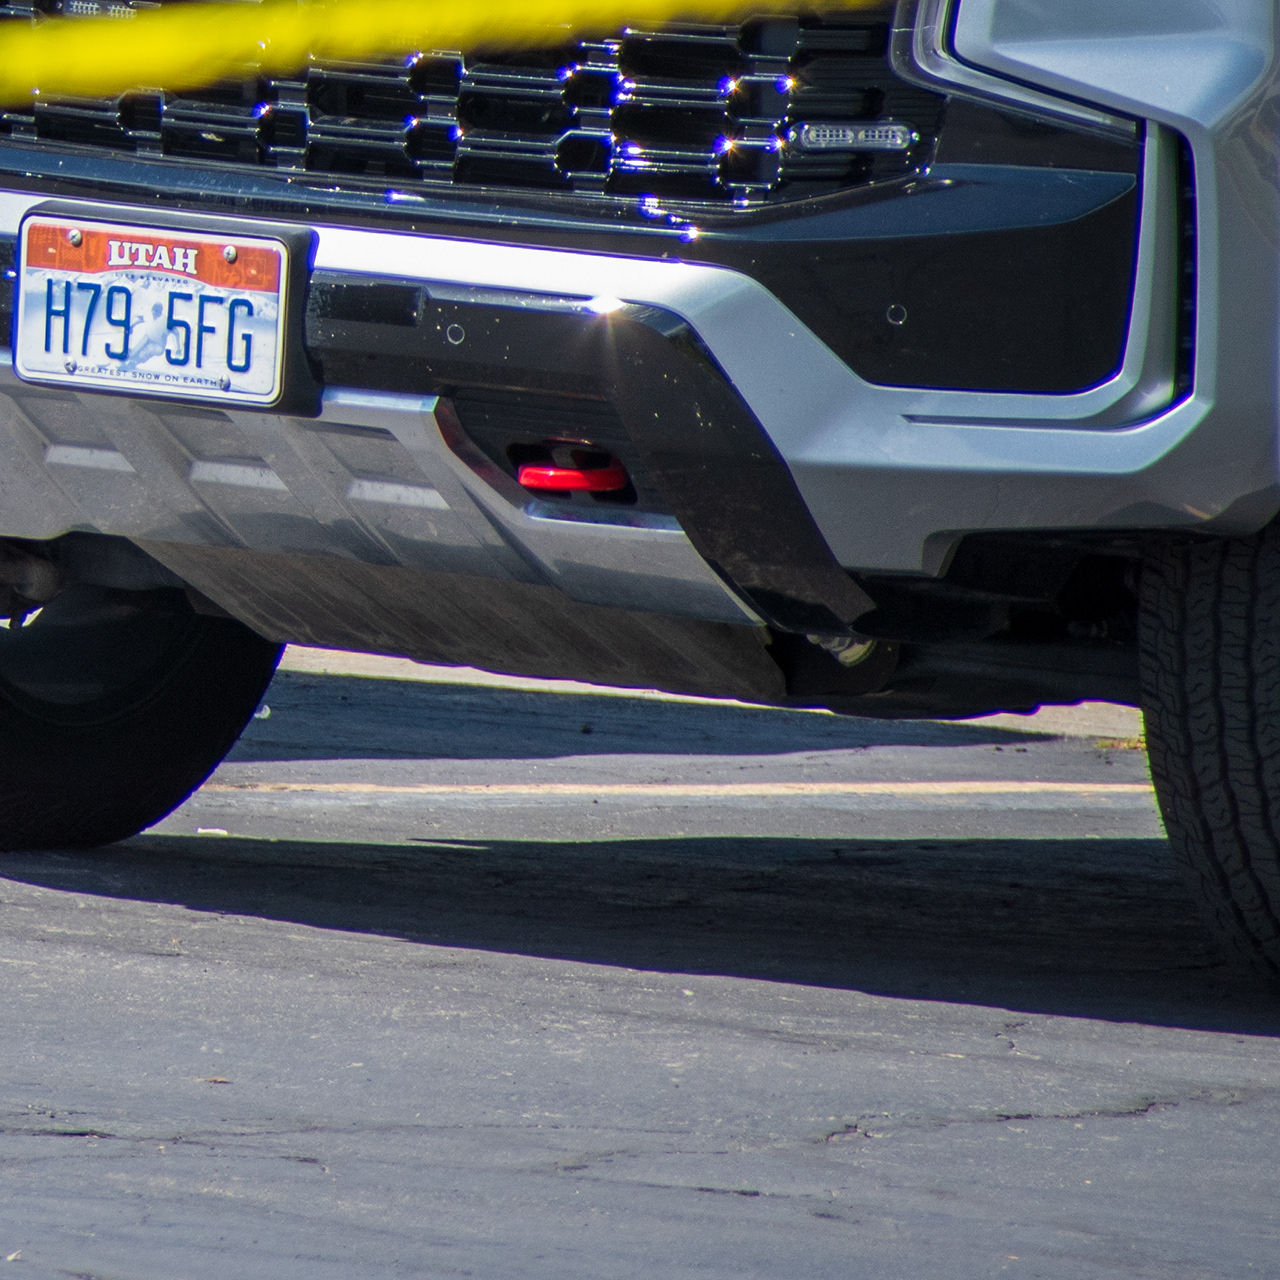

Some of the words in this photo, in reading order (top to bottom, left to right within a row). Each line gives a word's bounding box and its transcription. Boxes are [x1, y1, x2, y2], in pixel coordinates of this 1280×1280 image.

[107, 239, 199, 275] UTAH
[44, 278, 132, 360] H79
[164, 291, 254, 374] 5FG
[77, 365, 128, 377] GREATEST
[131, 372, 161, 381] SNOW
[164, 374, 179, 382] ON
[183, 376, 217, 386] EARTH
